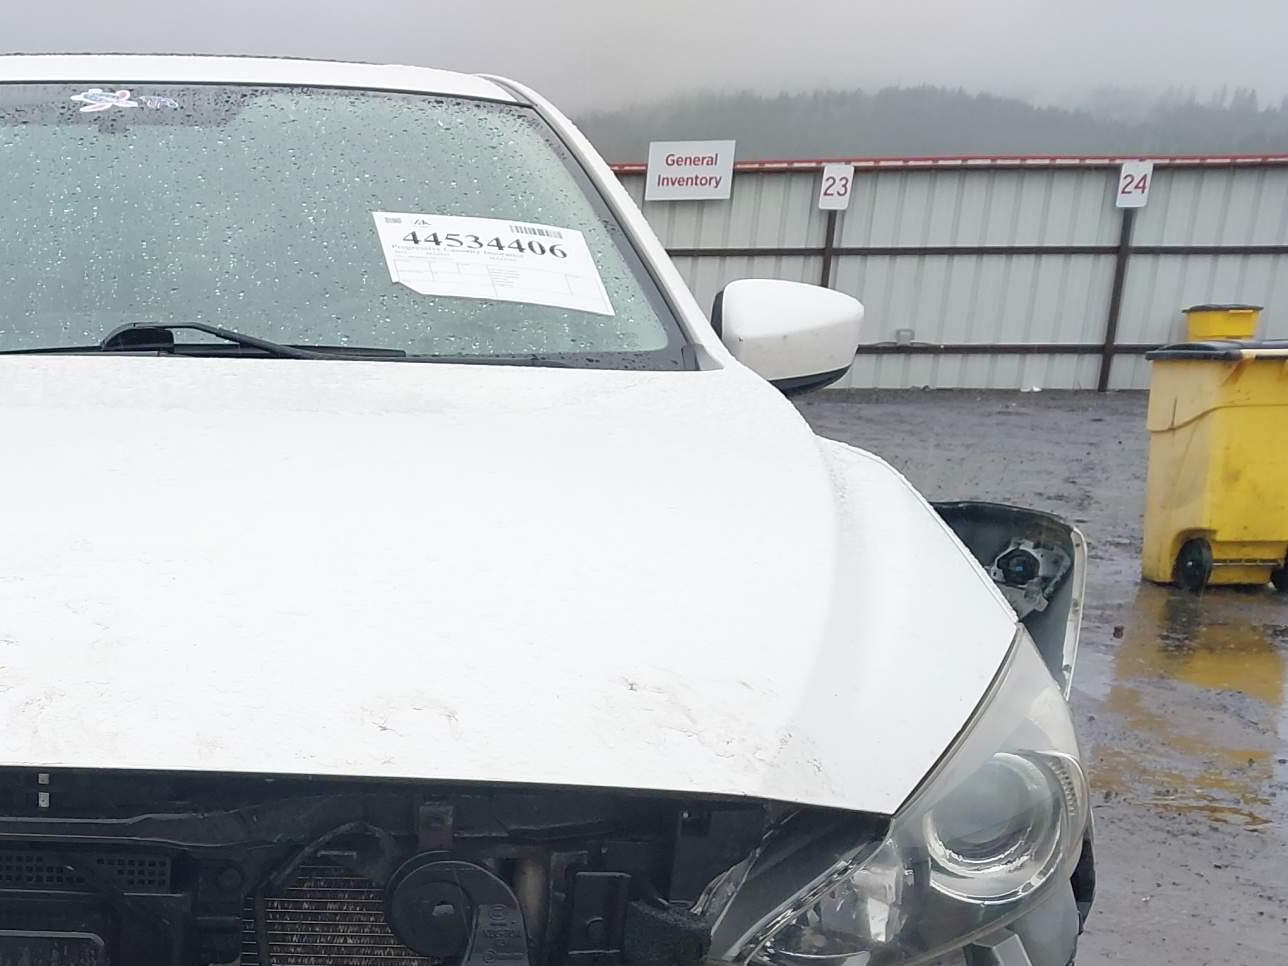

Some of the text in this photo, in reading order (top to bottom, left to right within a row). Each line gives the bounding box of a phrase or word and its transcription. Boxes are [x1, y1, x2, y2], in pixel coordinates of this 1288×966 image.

[665, 152, 719, 166] General
[656, 173, 723, 189] Inventory
[823, 176, 849, 197] 23
[1120, 173, 1148, 195] 24
[402, 231, 569, 260] 44534406
